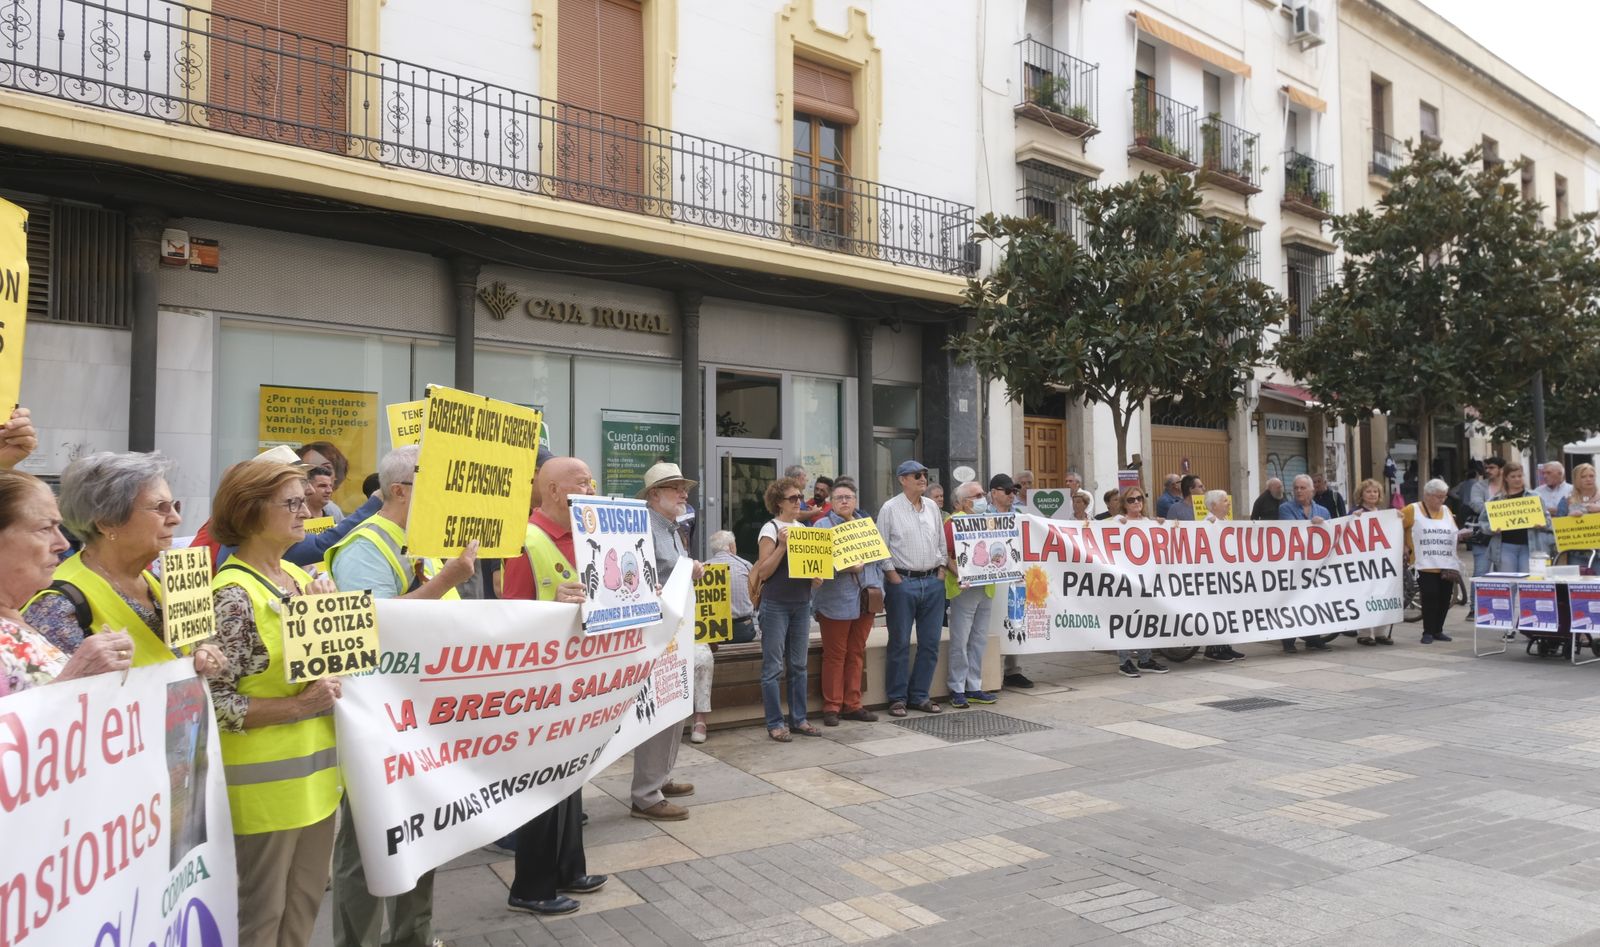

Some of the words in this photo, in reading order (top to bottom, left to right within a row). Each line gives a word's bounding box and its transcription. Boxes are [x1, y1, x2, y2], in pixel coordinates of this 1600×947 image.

[526, 299, 589, 325] CAJA
[592, 305, 673, 335] RURAL
[266, 394, 292, 404] ¿Por
[295, 395, 315, 405] qué
[318, 397, 367, 408] quedarte
[266, 415, 316, 426] variable,
[319, 416, 328, 426] si
[331, 417, 368, 429] puedes
[307, 407, 328, 417] tipo
[332, 408, 349, 418] fijo
[401, 408, 424, 420] TENE
[266, 425, 297, 433] tener
[300, 425, 316, 434] los
[319, 426, 343, 436] dos?
[428, 397, 474, 438] GOBIERNE
[475, 408, 502, 443] QUIEN
[502, 415, 538, 451] GOBIERNE
[1265, 418, 1307, 433] KURTUBA
[607, 431, 643, 442] Cuenta
[645, 433, 676, 444] online
[613, 441, 670, 452] autónomos
[445, 459, 466, 493] LAS
[465, 461, 513, 498] PENSIONES
[1489, 507, 1542, 518] RESIDENCIAS
[1491, 500, 1535, 510] AUDITORIA
[599, 508, 648, 535] BUSCAN
[834, 524, 857, 534] FALTA
[1506, 517, 1529, 527] ¡YA!
[443, 515, 458, 548] SE
[457, 516, 503, 549] DEFIENDEN
[789, 530, 831, 542] AUDITORIA
[1021, 520, 1215, 567] LATAFORMA
[1219, 516, 1393, 565] CIUDADANA
[789, 544, 832, 556] RESIDENCIAS
[843, 539, 881, 555] MALTRATO
[843, 557, 849, 565] A
[850, 555, 860, 563] LA
[860, 549, 882, 561] VEJEZ
[165, 553, 184, 572] ESTA
[187, 552, 195, 569] ES
[199, 551, 208, 568] LA
[802, 559, 823, 575] ¡YA!
[1062, 571, 1132, 598] PARA
[1140, 573, 1163, 598] LA
[1170, 569, 1256, 598] DEFENSA
[1261, 568, 1297, 594] DEL
[1301, 557, 1397, 590] SISTEMA
[287, 600, 308, 617] YO
[316, 594, 371, 613] COTIZO
[586, 607, 621, 624] LADRONES
[621, 605, 630, 618] DE
[630, 602, 660, 617] PENSIONES
[700, 604, 716, 618] EL
[1366, 594, 1402, 613] CÓRDOBA
[286, 616, 306, 639] TÚ
[313, 612, 374, 635] COTIZAS
[1055, 609, 1100, 629] CÓRDOBA
[1109, 609, 1210, 639] PÚBLICO
[1213, 611, 1239, 635] DE
[1243, 599, 1361, 633] PENSIONES
[169, 623, 179, 643] LA
[302, 642, 313, 657] Y
[321, 636, 364, 655] ELLOS
[425, 639, 563, 676] JUNTAS
[564, 628, 643, 662] CONTRA
[290, 649, 377, 680] ROBAN
[681, 665, 690, 700] Córdoba
[385, 698, 418, 732] LA
[428, 683, 562, 725] BRECHA
[101, 700, 144, 765] en
[383, 752, 415, 785] EN
[419, 730, 518, 773] SALARIOS
[527, 725, 543, 747] Y
[545, 718, 576, 742] EN
[578, 697, 635, 733] PENSI
[433, 795, 483, 832] UNAS
[480, 753, 589, 813] PENSIONES
[0, 792, 161, 947] nsiones
